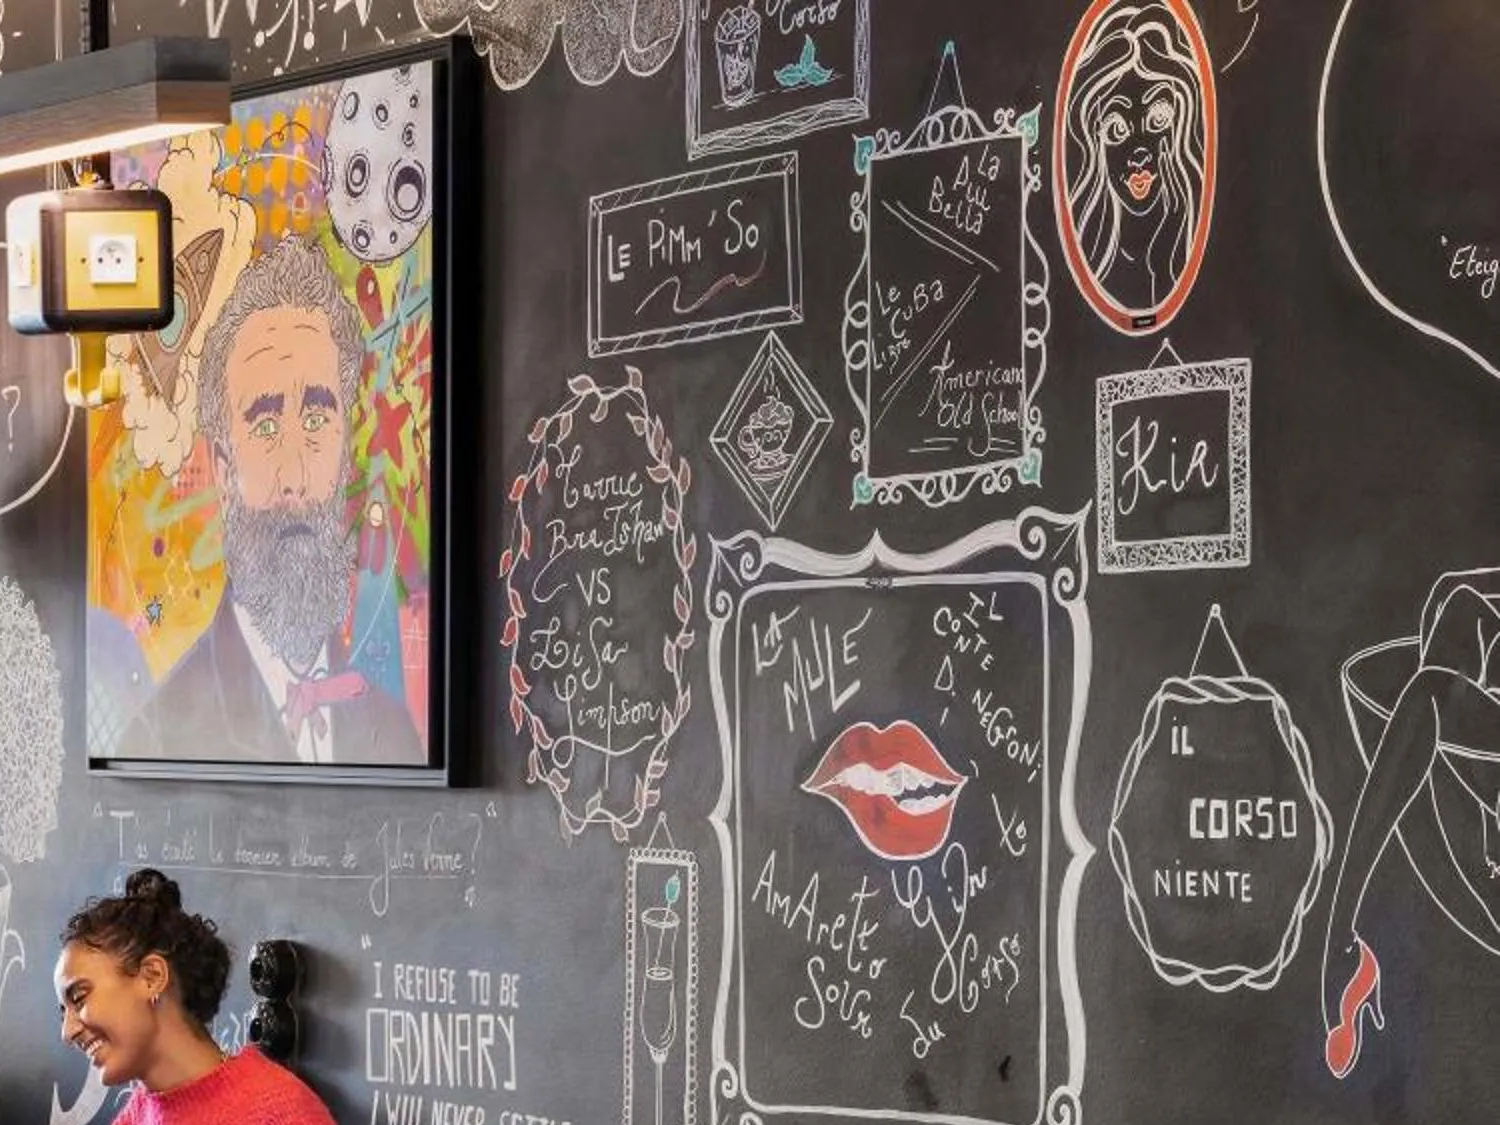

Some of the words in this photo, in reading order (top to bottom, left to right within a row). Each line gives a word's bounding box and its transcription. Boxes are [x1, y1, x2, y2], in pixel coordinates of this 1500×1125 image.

[1189, 797, 1298, 840] CORSO
[373, 961, 383, 999] I
[393, 963, 457, 1005] REFUSE
[467, 969, 492, 1006] TO
[499, 973, 521, 1009] BE
[366, 1007, 517, 1091] ORDINARY
